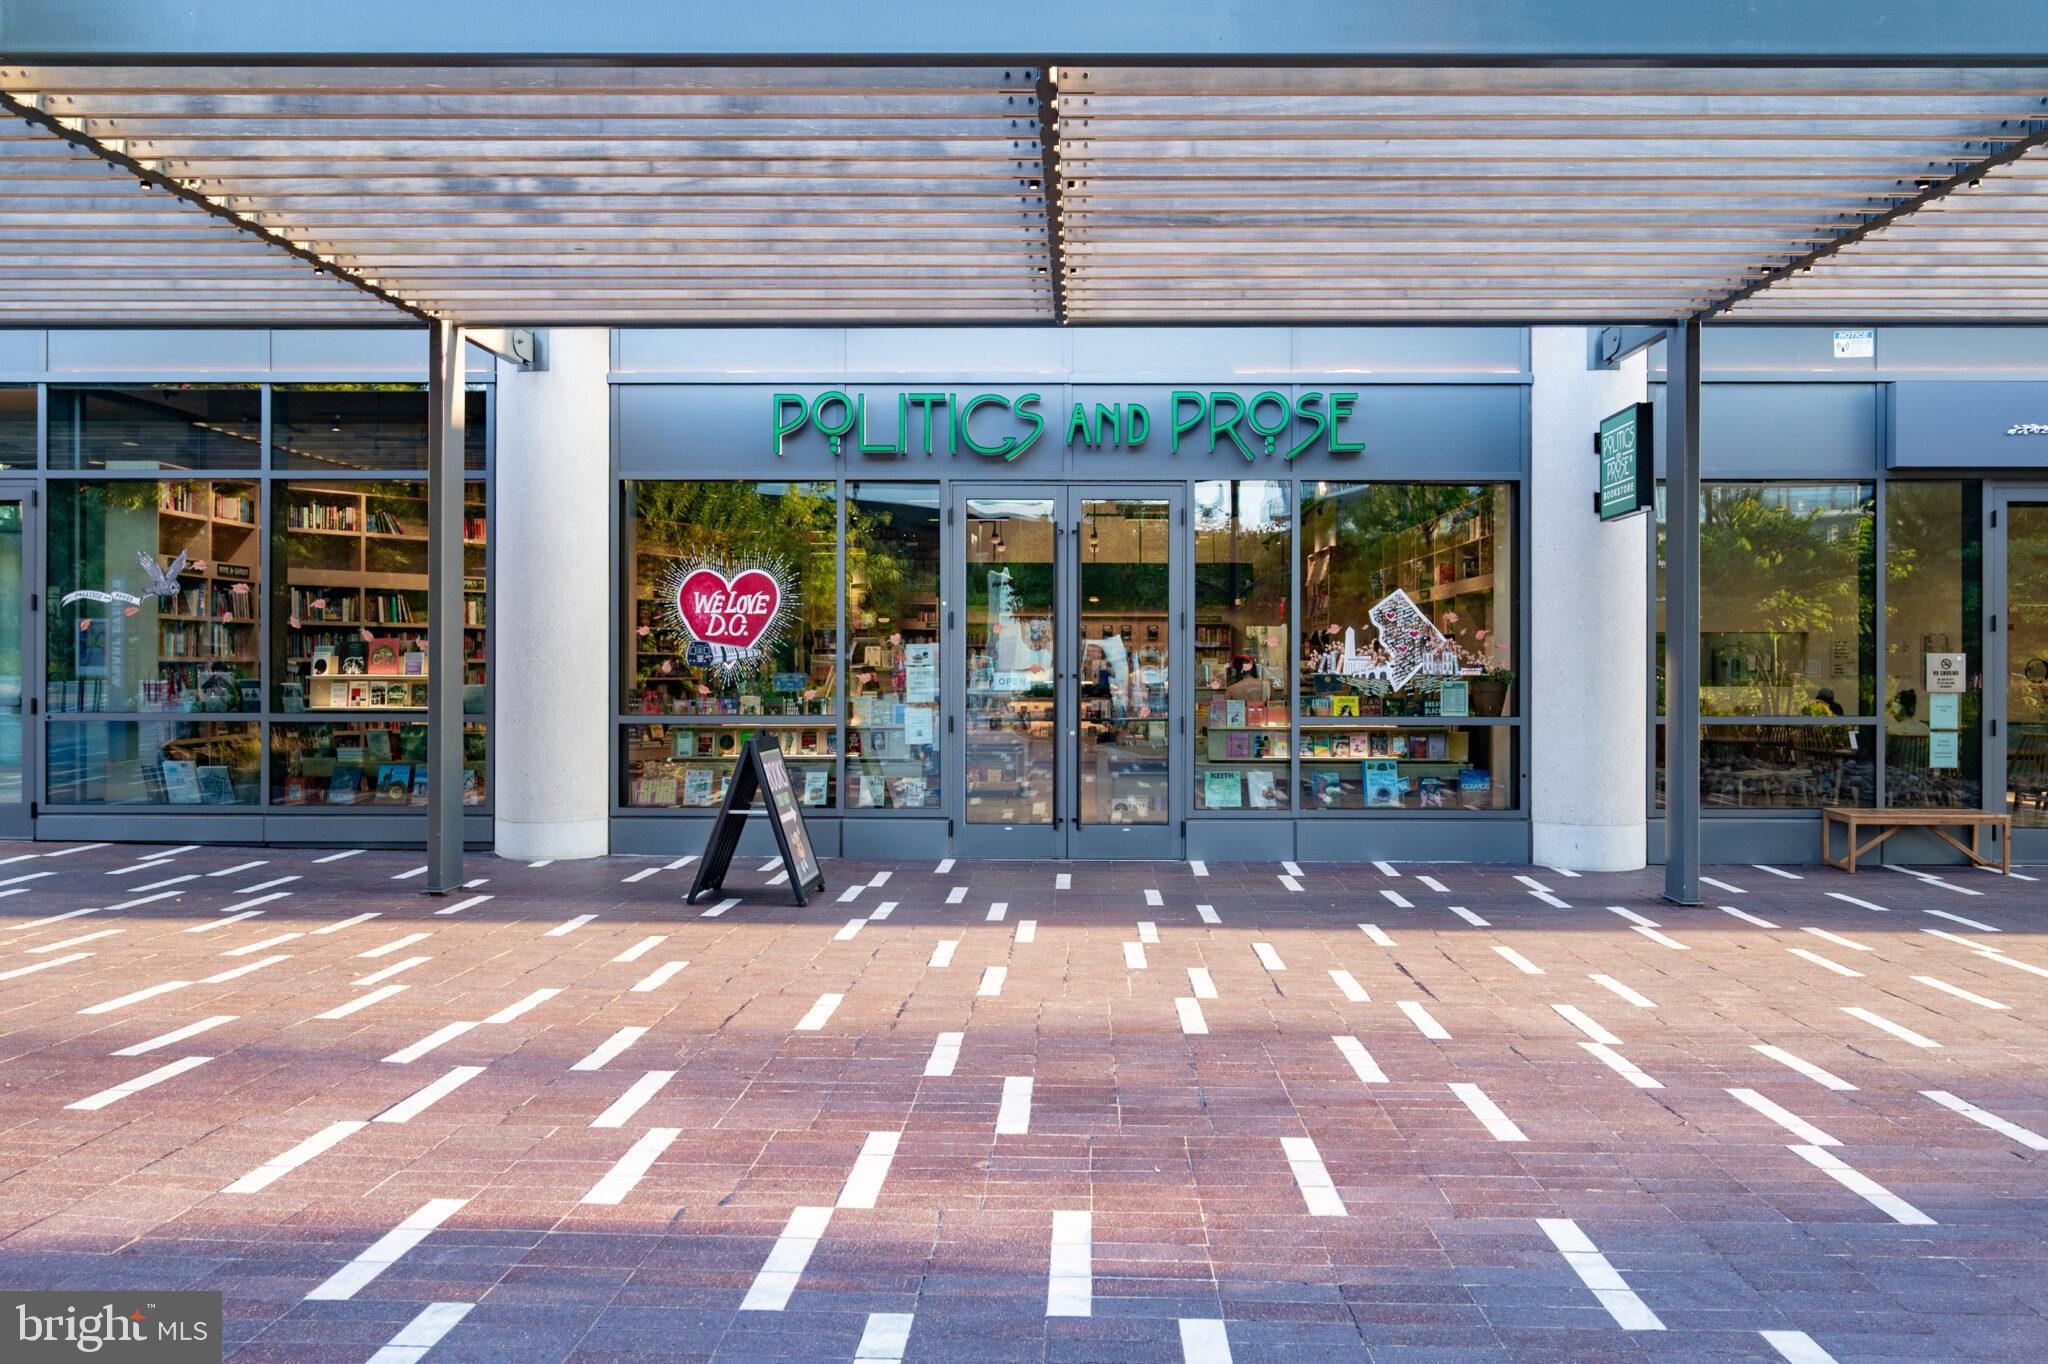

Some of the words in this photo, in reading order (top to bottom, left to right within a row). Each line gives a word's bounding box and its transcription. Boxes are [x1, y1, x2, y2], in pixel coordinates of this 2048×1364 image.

[772, 390, 1046, 462] POLITICS
[1066, 402, 1150, 447] AND
[1170, 390, 1367, 462] PROSE
[1603, 425, 1635, 458] POLITICS
[1606, 455, 1630, 483] PROSE
[1603, 482, 1635, 501] BOOKSTORE
[693, 589, 726, 614] WE
[724, 591, 770, 615] LOVE
[705, 613, 749, 637] D.C.
[998, 677, 1026, 686] OPEN
